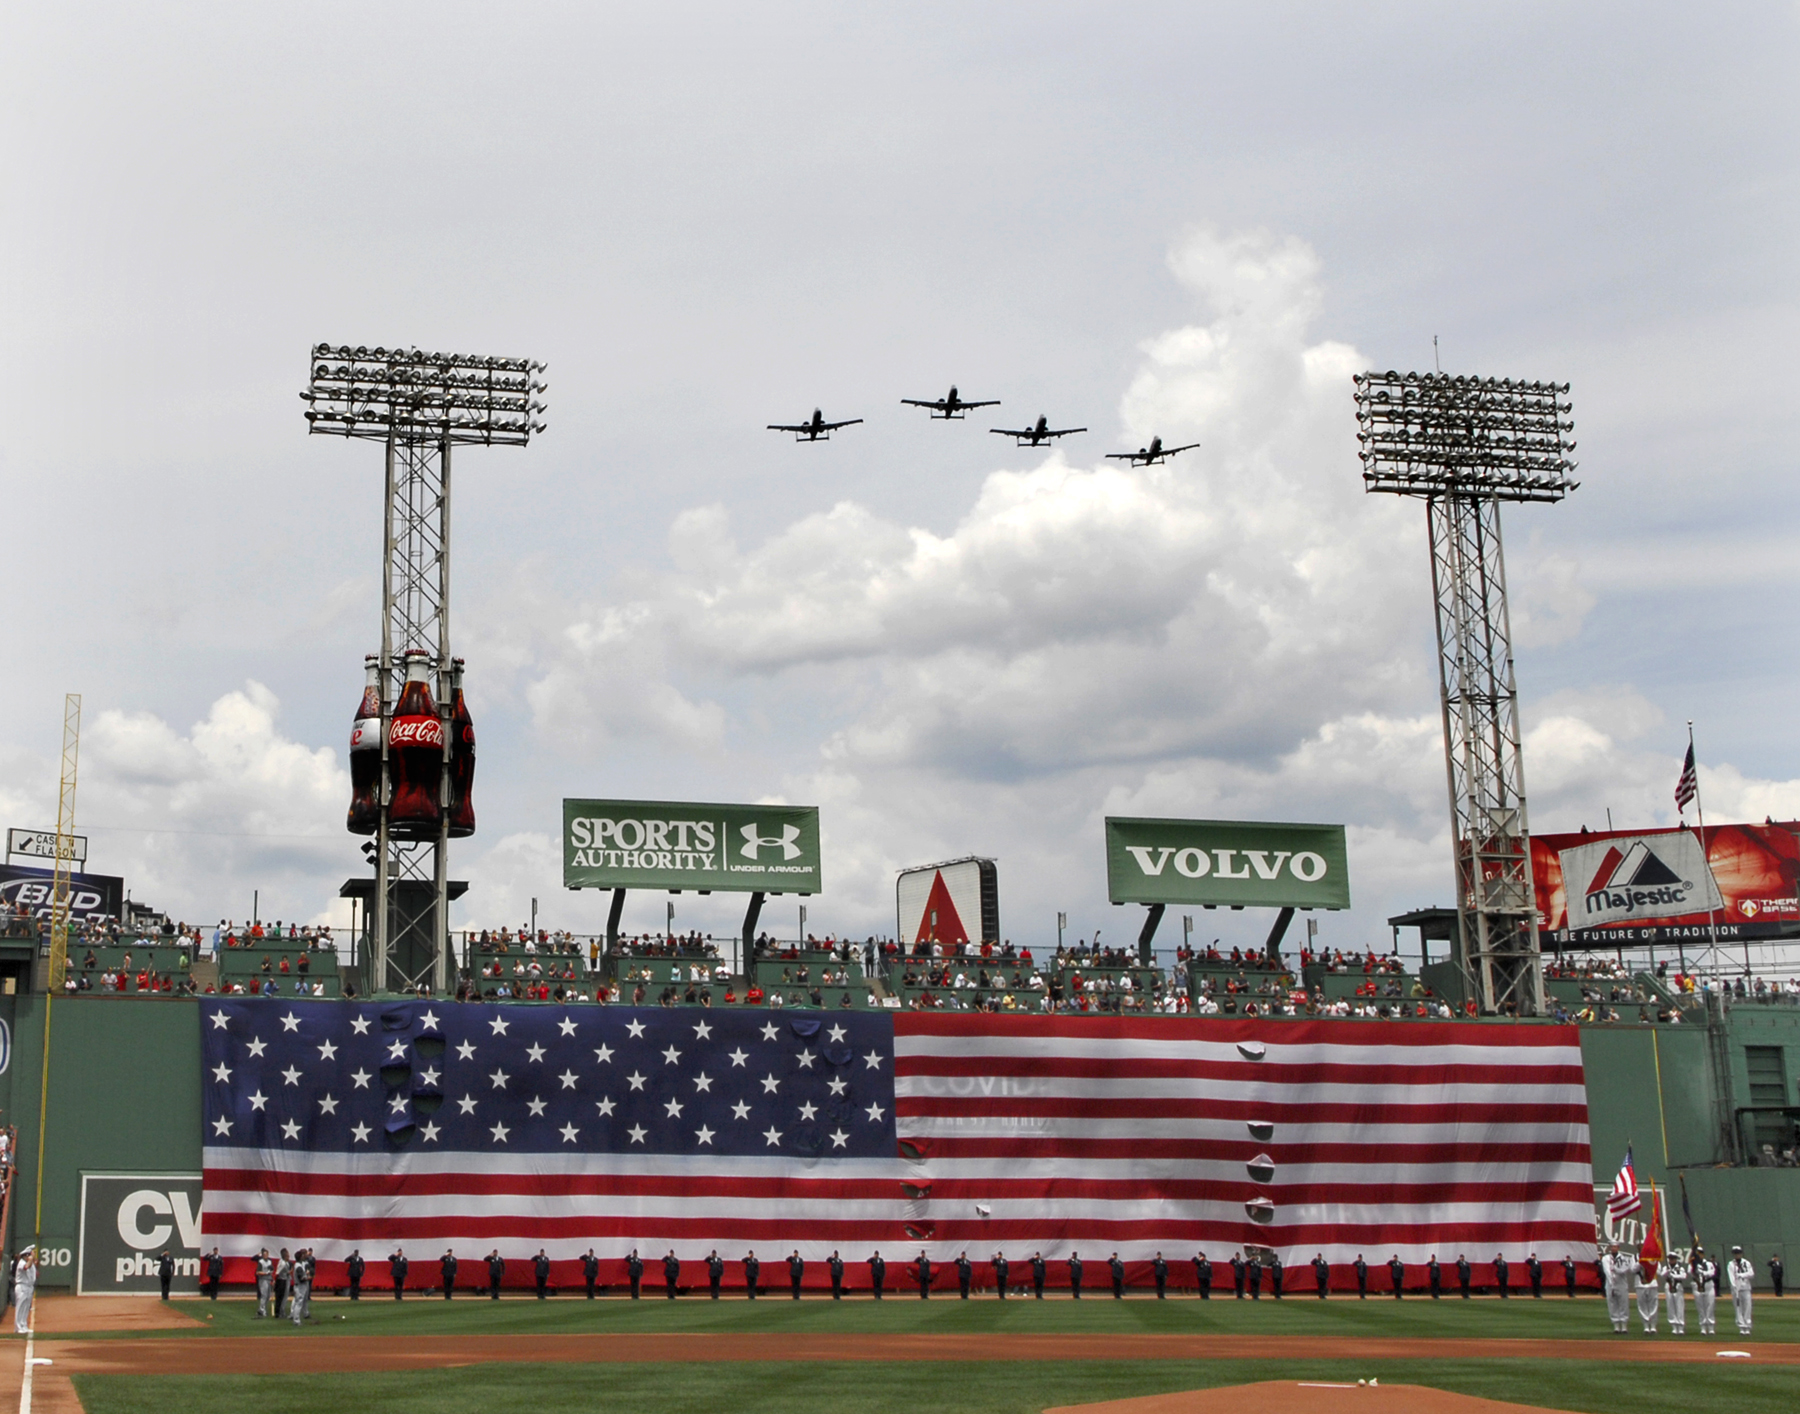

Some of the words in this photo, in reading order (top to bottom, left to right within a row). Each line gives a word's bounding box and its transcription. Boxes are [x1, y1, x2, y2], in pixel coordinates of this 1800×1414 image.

[389, 719, 443, 745] Coca-Cola
[36, 834, 59, 846] CAS
[571, 817, 716, 852] SPORTS
[571, 850, 715, 871] AUTHORITY
[730, 865, 765, 873] UNDER
[1125, 846, 1327, 882] VOLVO
[15, 883, 102, 910] BUD
[1585, 887, 1687, 914] Majestic
[1552, 932, 1576, 942] TE
[1583, 930, 1634, 941] FUTURE
[1641, 928, 1657, 938] O
[1665, 926, 1739, 937] TRADITION
[40, 1248, 71, 1267] 310
